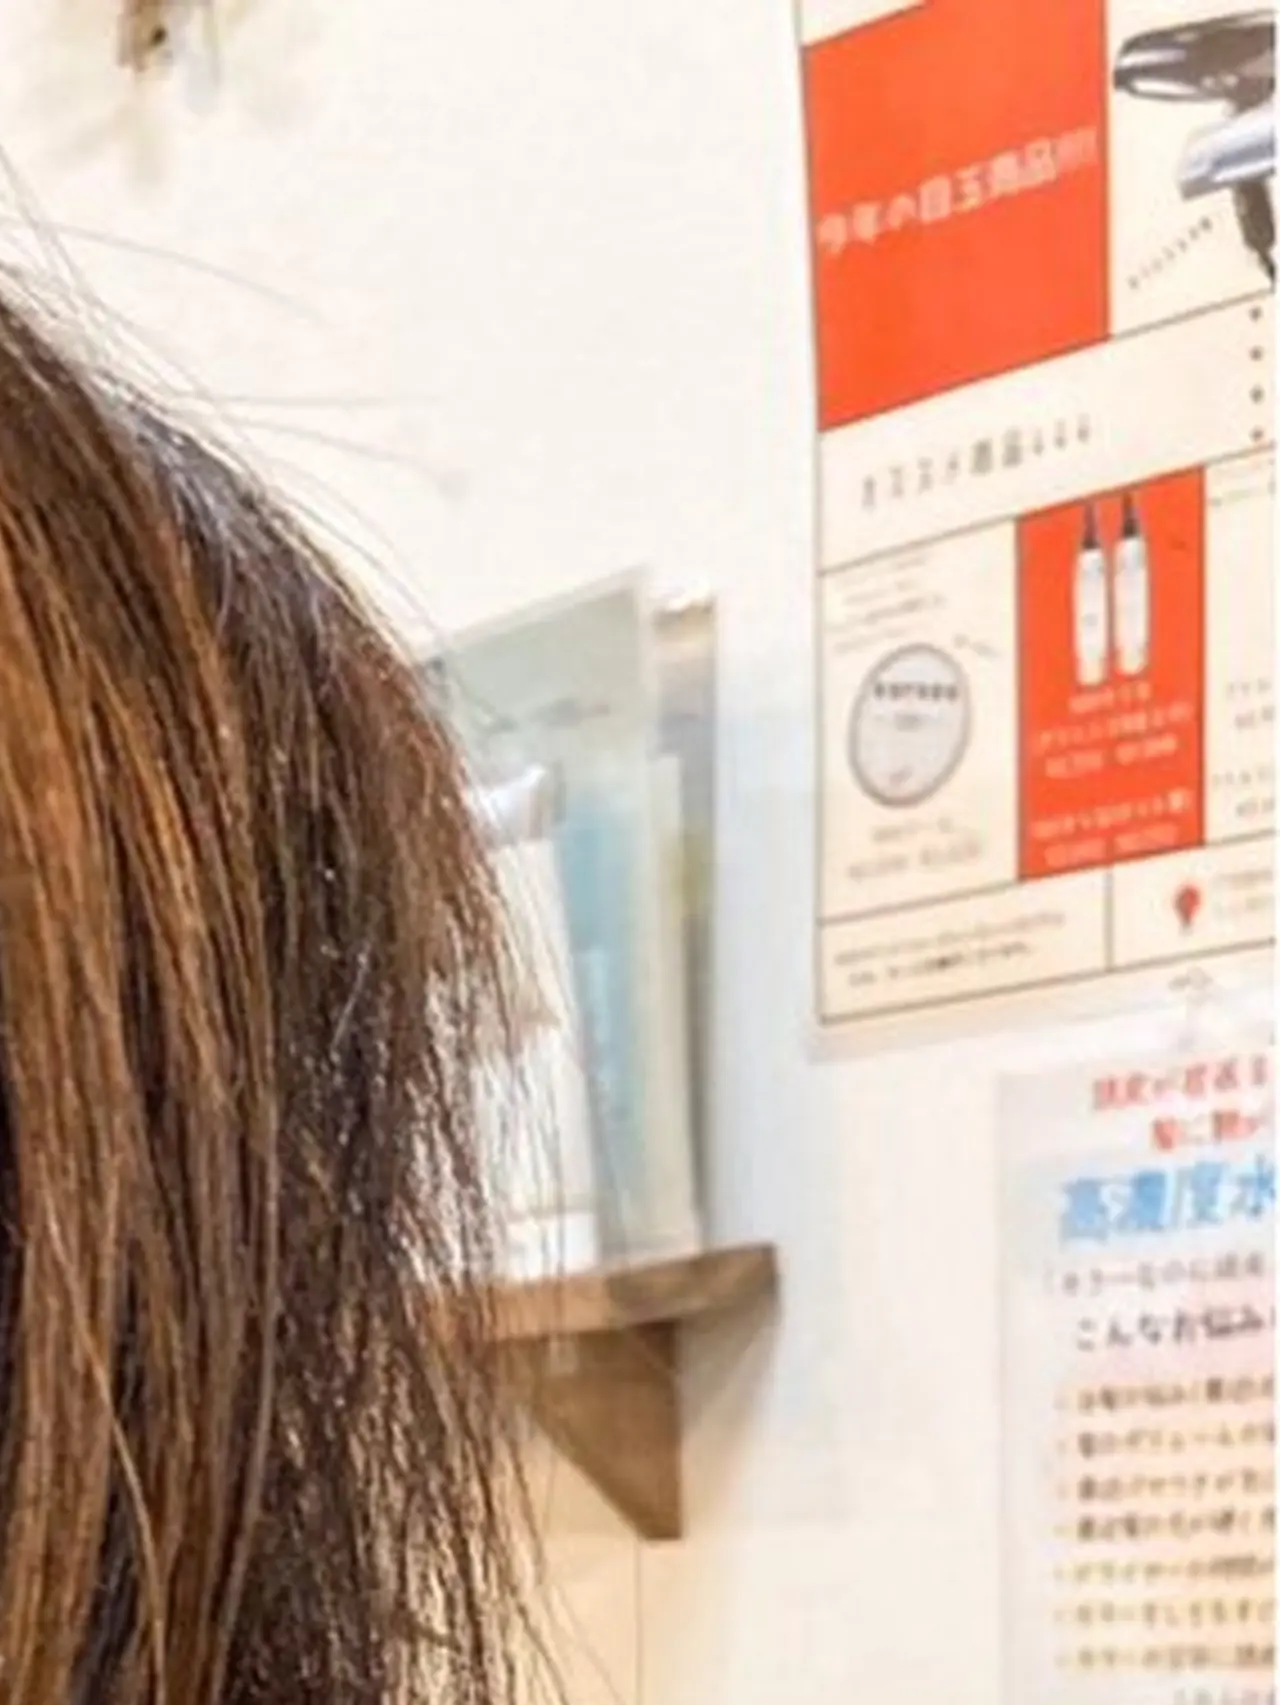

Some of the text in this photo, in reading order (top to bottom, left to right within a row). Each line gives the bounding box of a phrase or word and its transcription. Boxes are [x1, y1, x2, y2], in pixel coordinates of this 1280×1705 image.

[1077, 1304, 1276, 1352] こんなお悩み
